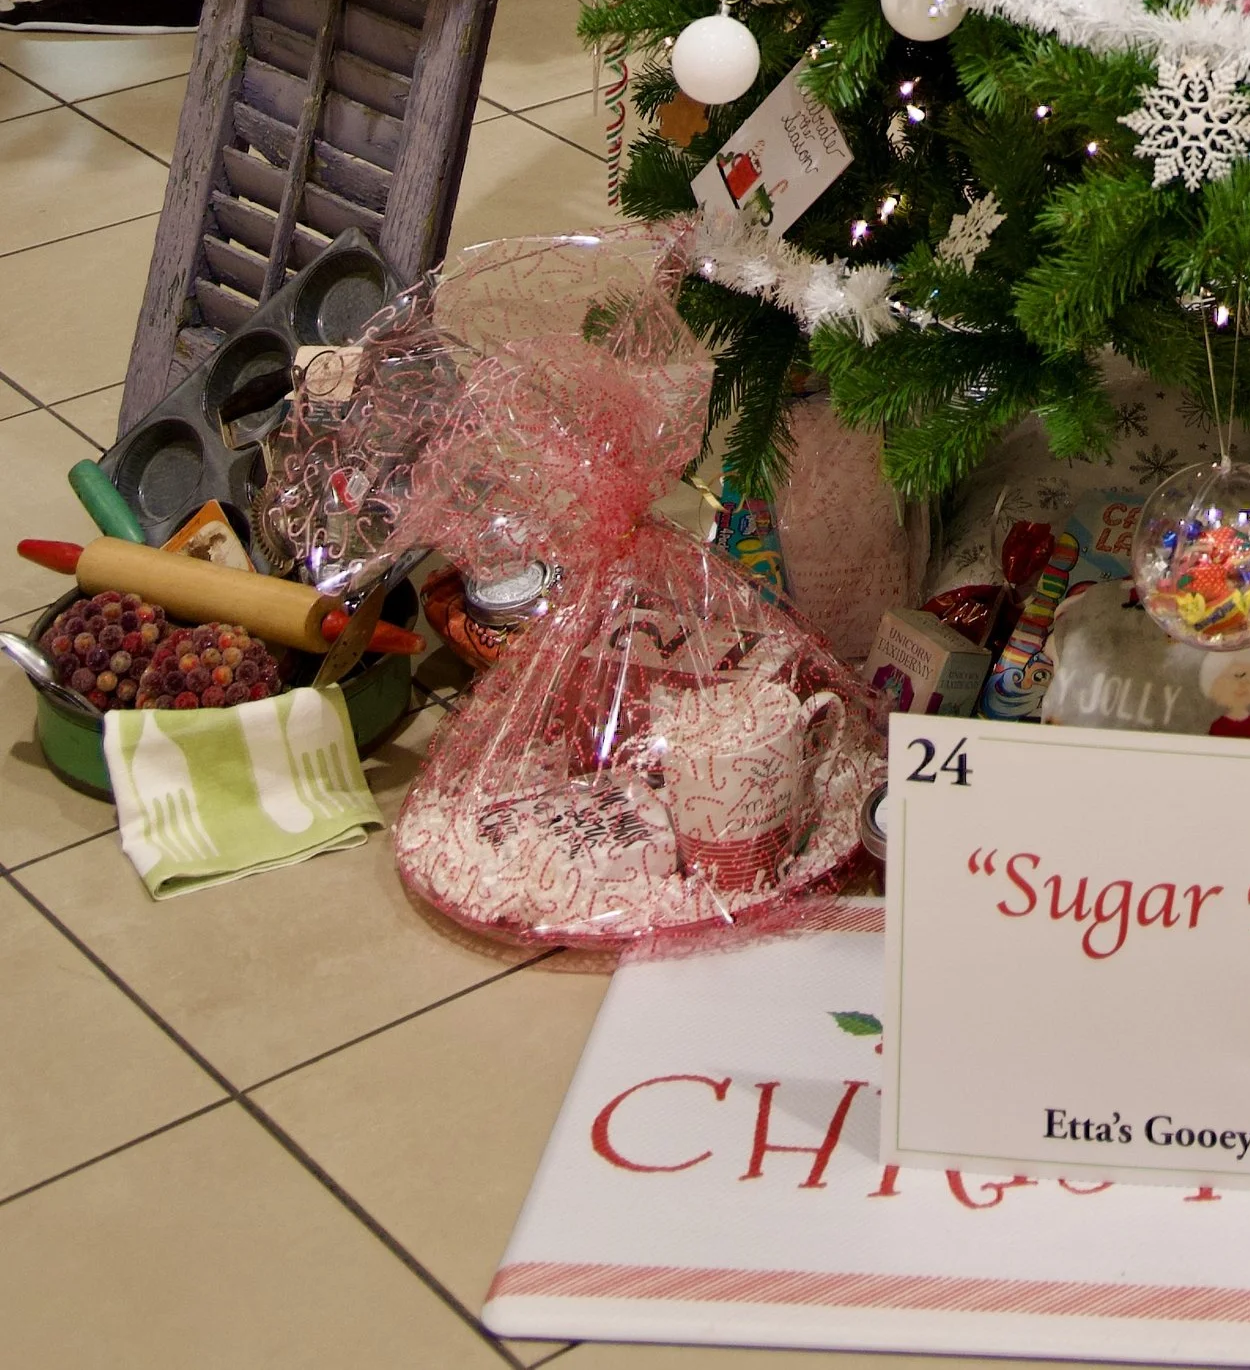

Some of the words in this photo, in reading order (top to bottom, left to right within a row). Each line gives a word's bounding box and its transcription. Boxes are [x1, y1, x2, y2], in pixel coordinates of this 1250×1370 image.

[877, 636, 934, 680] TAXIDERMY
[889, 627, 933, 664] UNICORN
[1080, 676, 1183, 725] JOLLY
[905, 736, 974, 787] 24
[967, 848, 1223, 960] “Sugar
[1043, 1107, 1133, 1145] Etta’s
